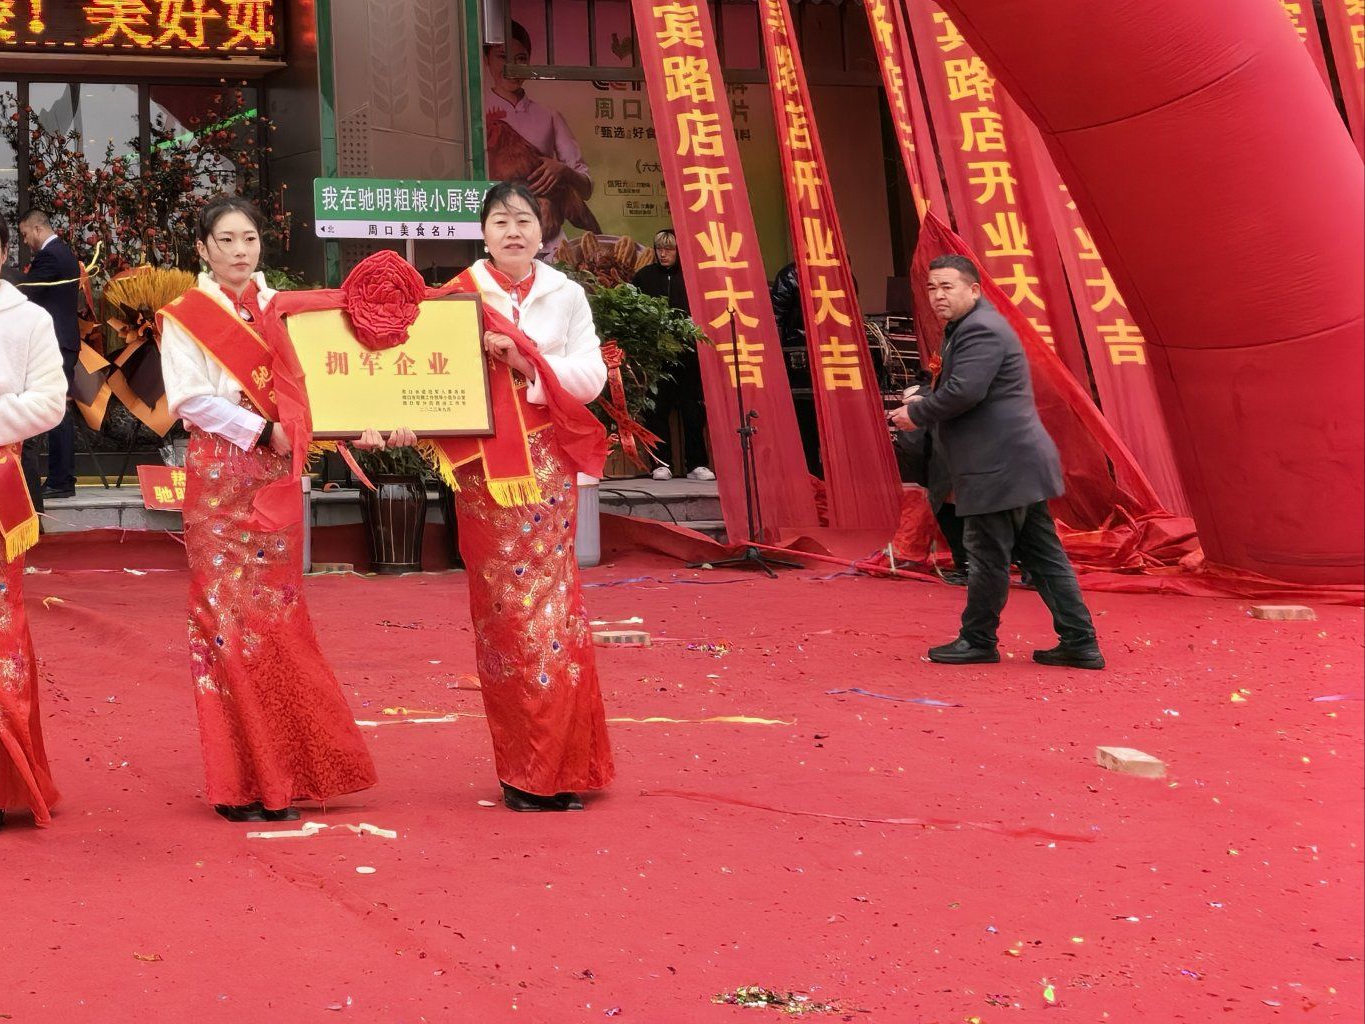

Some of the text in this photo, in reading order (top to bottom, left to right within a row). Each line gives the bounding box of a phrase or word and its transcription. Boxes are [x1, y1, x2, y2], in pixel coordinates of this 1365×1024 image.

[369, 224, 456, 237] 周口美食名片
[325, 351, 451, 376] 拥军企业
